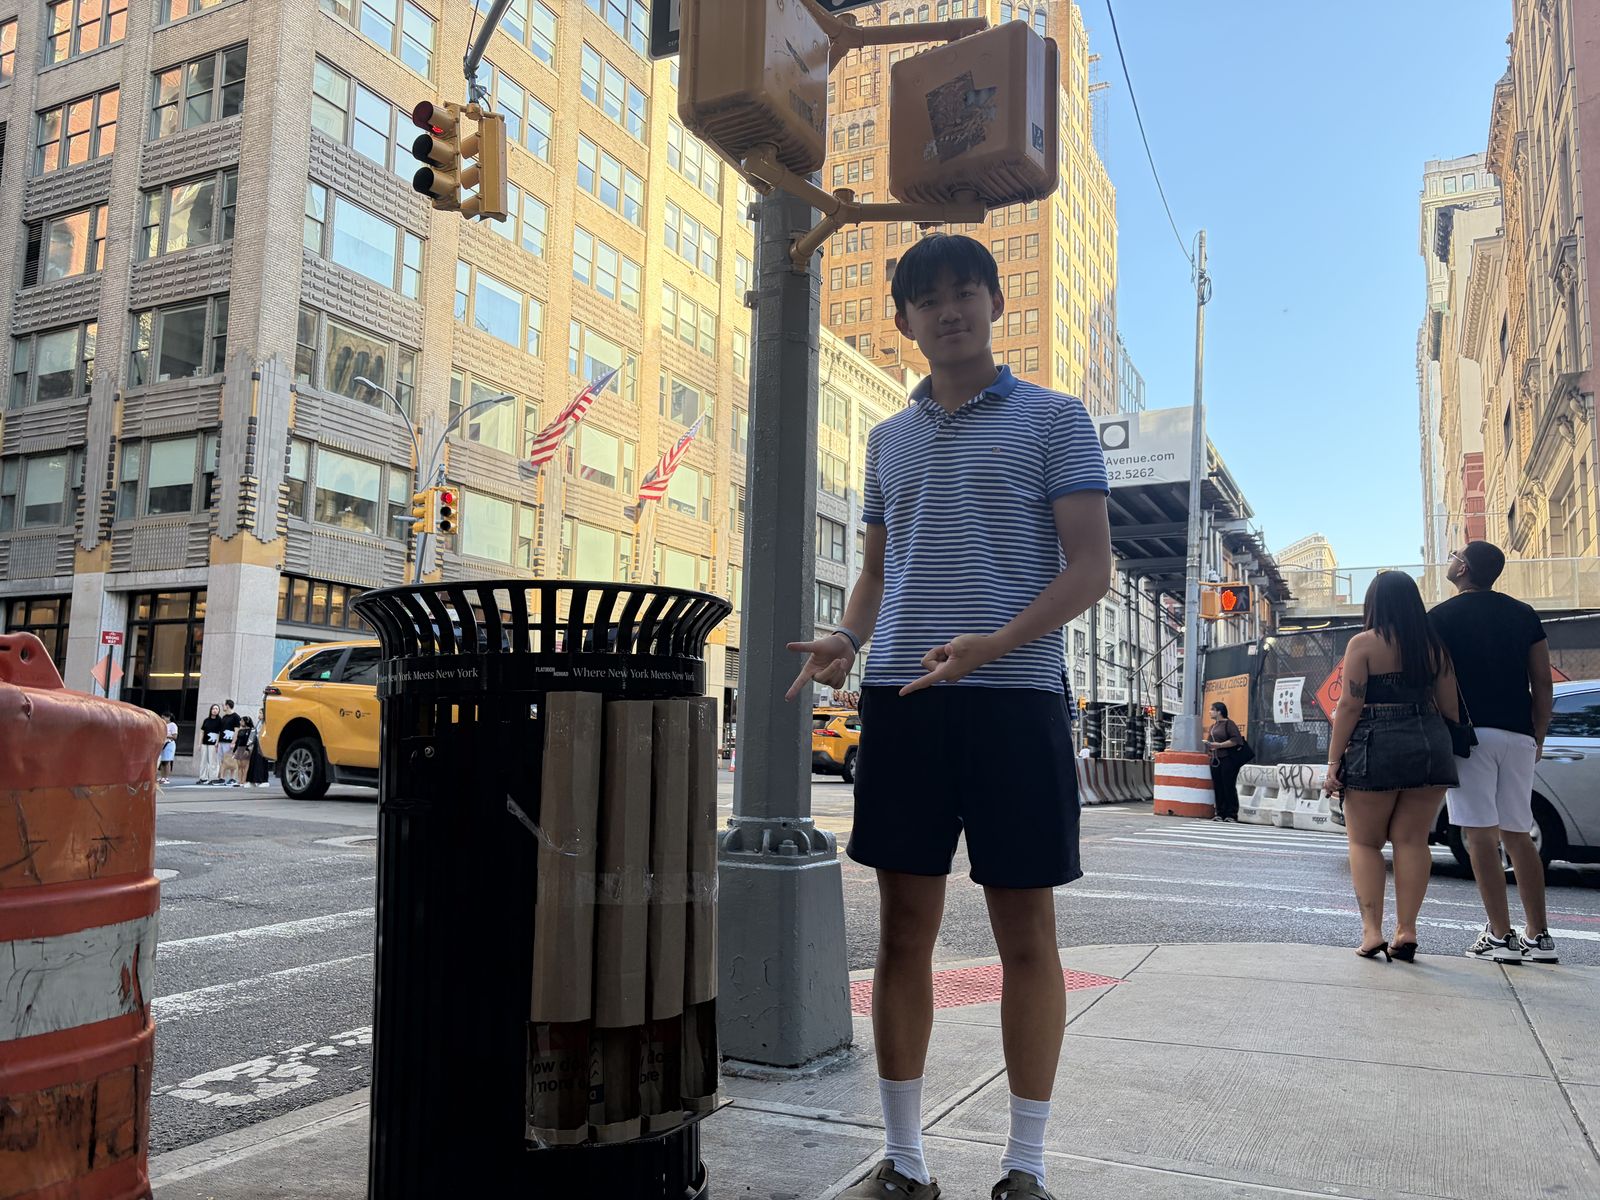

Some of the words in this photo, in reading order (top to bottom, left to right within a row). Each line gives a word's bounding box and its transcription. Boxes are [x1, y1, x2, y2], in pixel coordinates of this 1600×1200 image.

[1105, 452, 1175, 466] Avenue.com
[412, 671, 435, 680] Meets
[435, 669, 456, 679] New
[457, 667, 479, 678] York
[572, 667, 606, 677] Where
[607, 668, 628, 678] New
[629, 668, 649, 678] York
[650, 669, 671, 679] Meets
[671, 671, 684, 680] New
